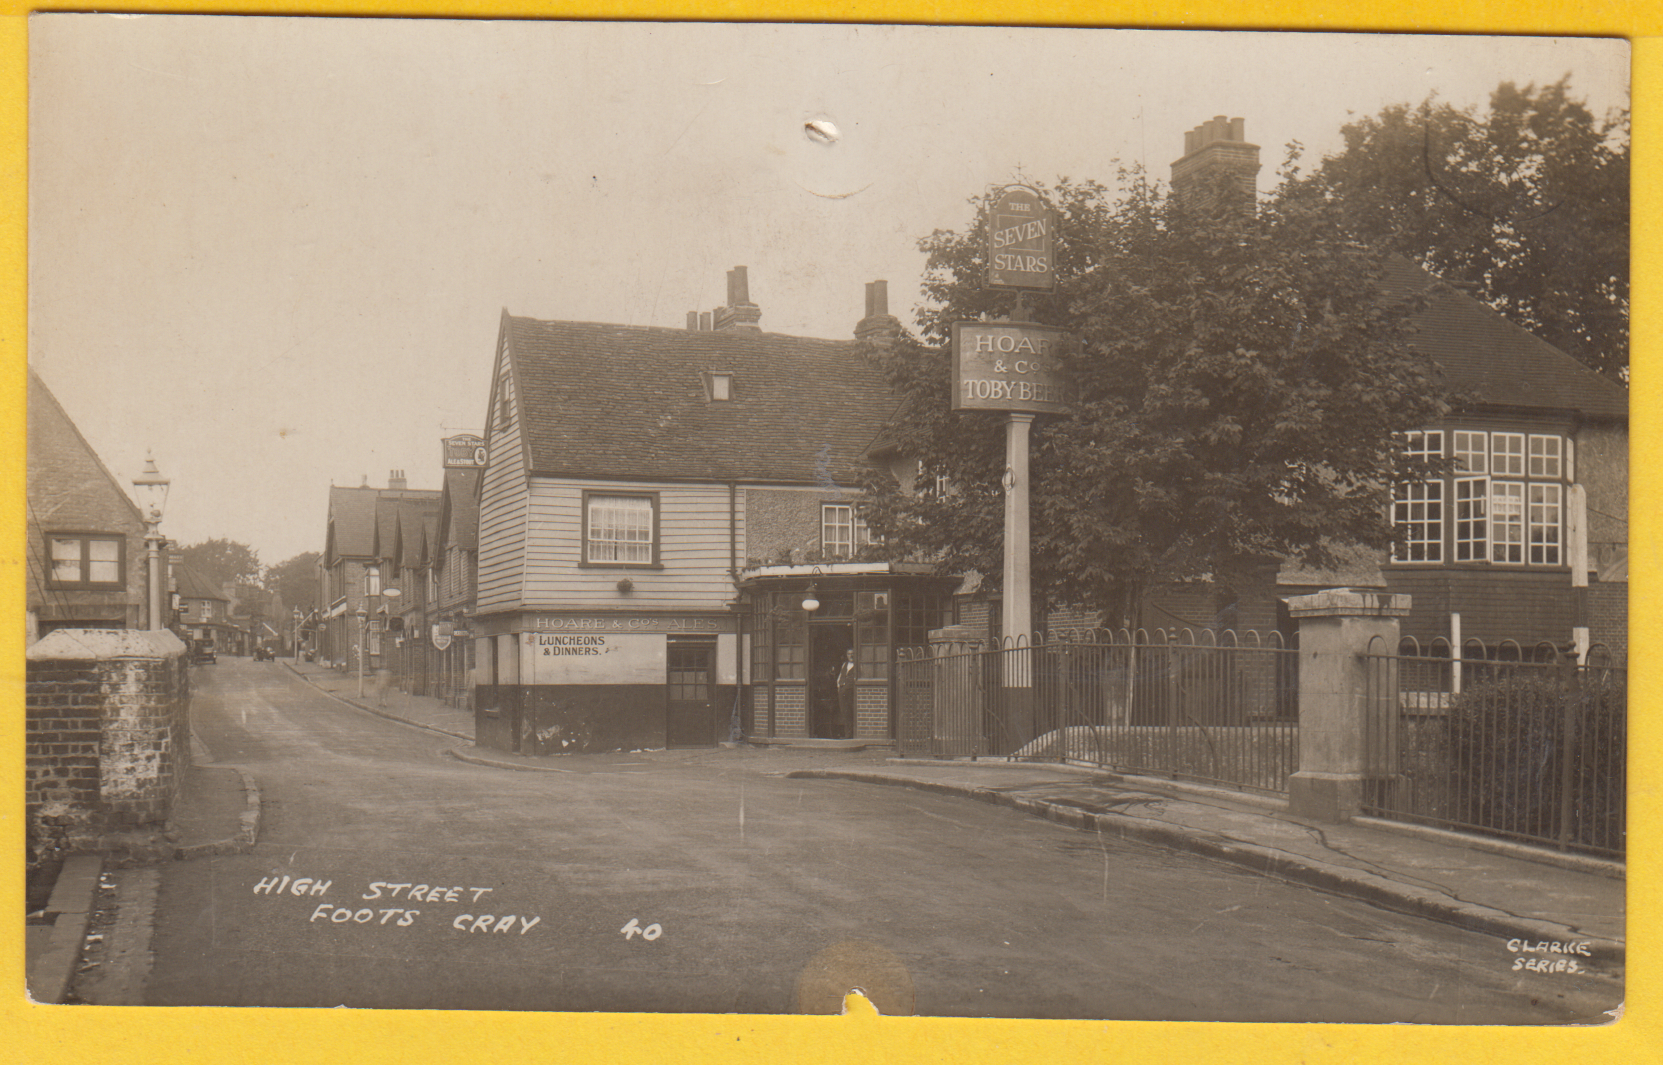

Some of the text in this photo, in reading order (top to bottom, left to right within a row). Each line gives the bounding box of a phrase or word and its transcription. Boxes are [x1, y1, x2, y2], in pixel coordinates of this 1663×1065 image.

[1009, 202, 1031, 212] THE
[993, 218, 1047, 249] SEVEN
[994, 254, 1048, 273] STARS
[994, 359, 1008, 373] &
[963, 380, 1017, 400] TOBY
[447, 446, 475, 458] TOBY
[536, 618, 605, 629] HOARE
[612, 619, 623, 629] &
[539, 635, 605, 646] LUNCHEONS
[543, 646, 602, 656] & DINNERS.
